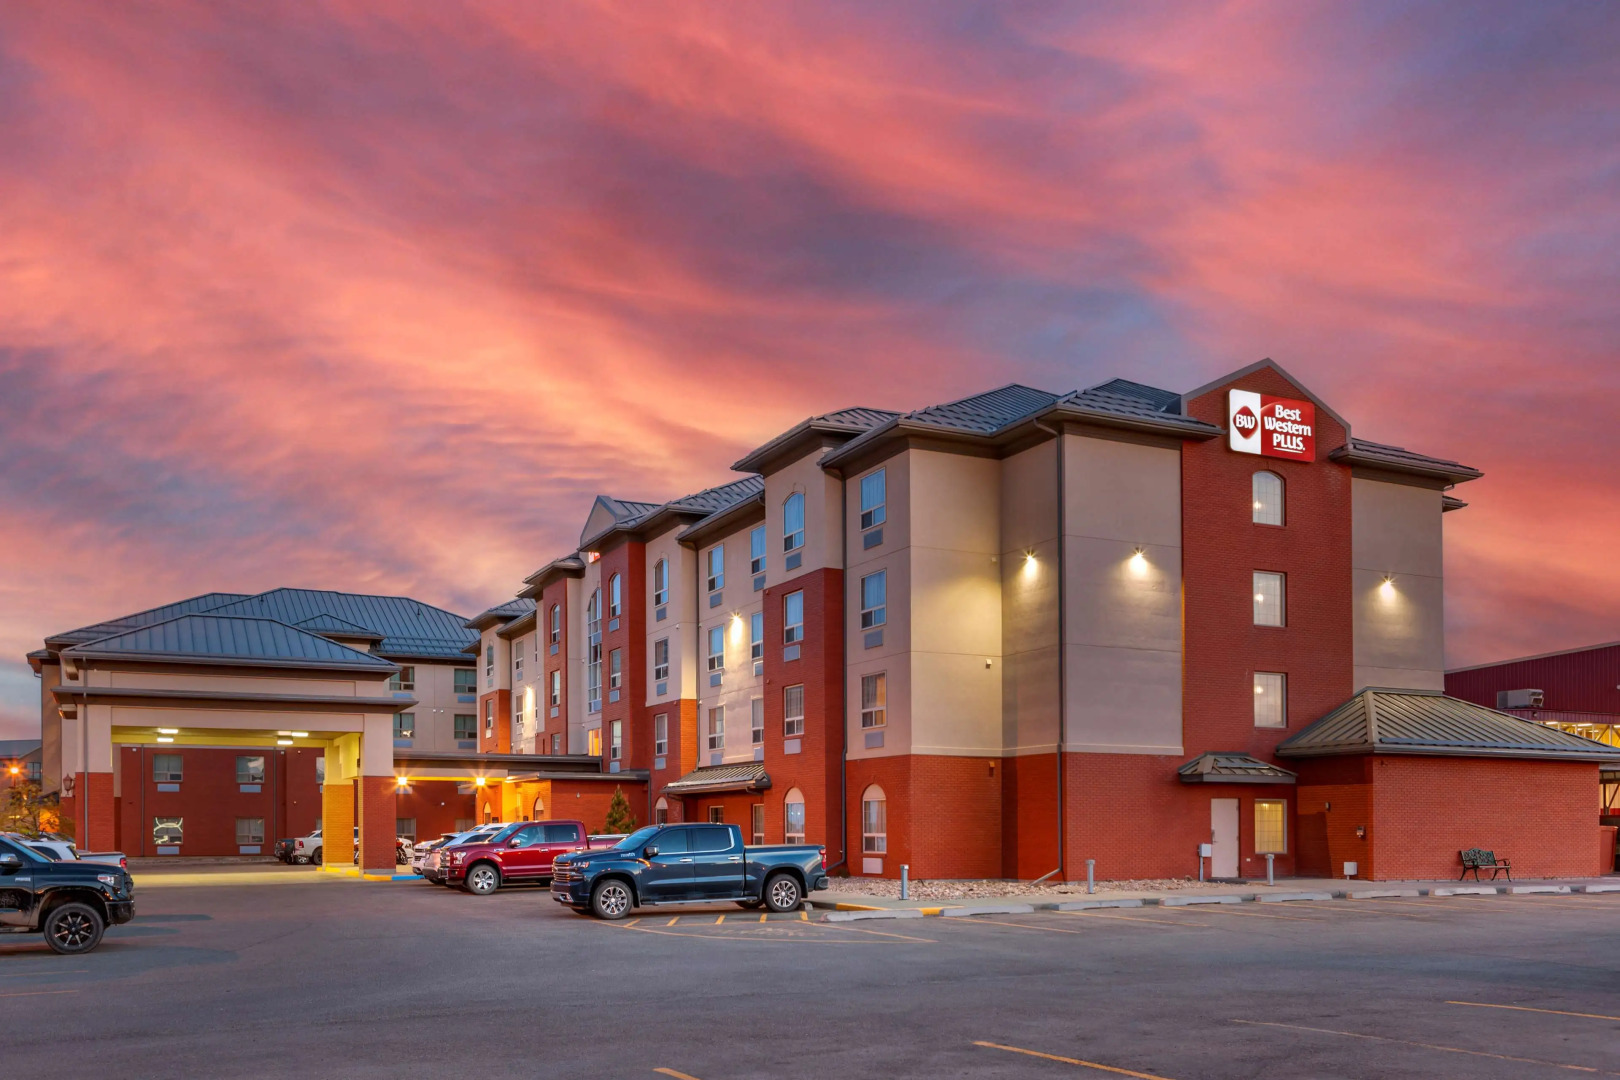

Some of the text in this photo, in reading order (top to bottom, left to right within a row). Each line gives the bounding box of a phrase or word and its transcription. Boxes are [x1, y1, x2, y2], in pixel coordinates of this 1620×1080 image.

[1275, 404, 1301, 421] Best
[1235, 414, 1256, 429] BW
[1263, 416, 1312, 436] Western
